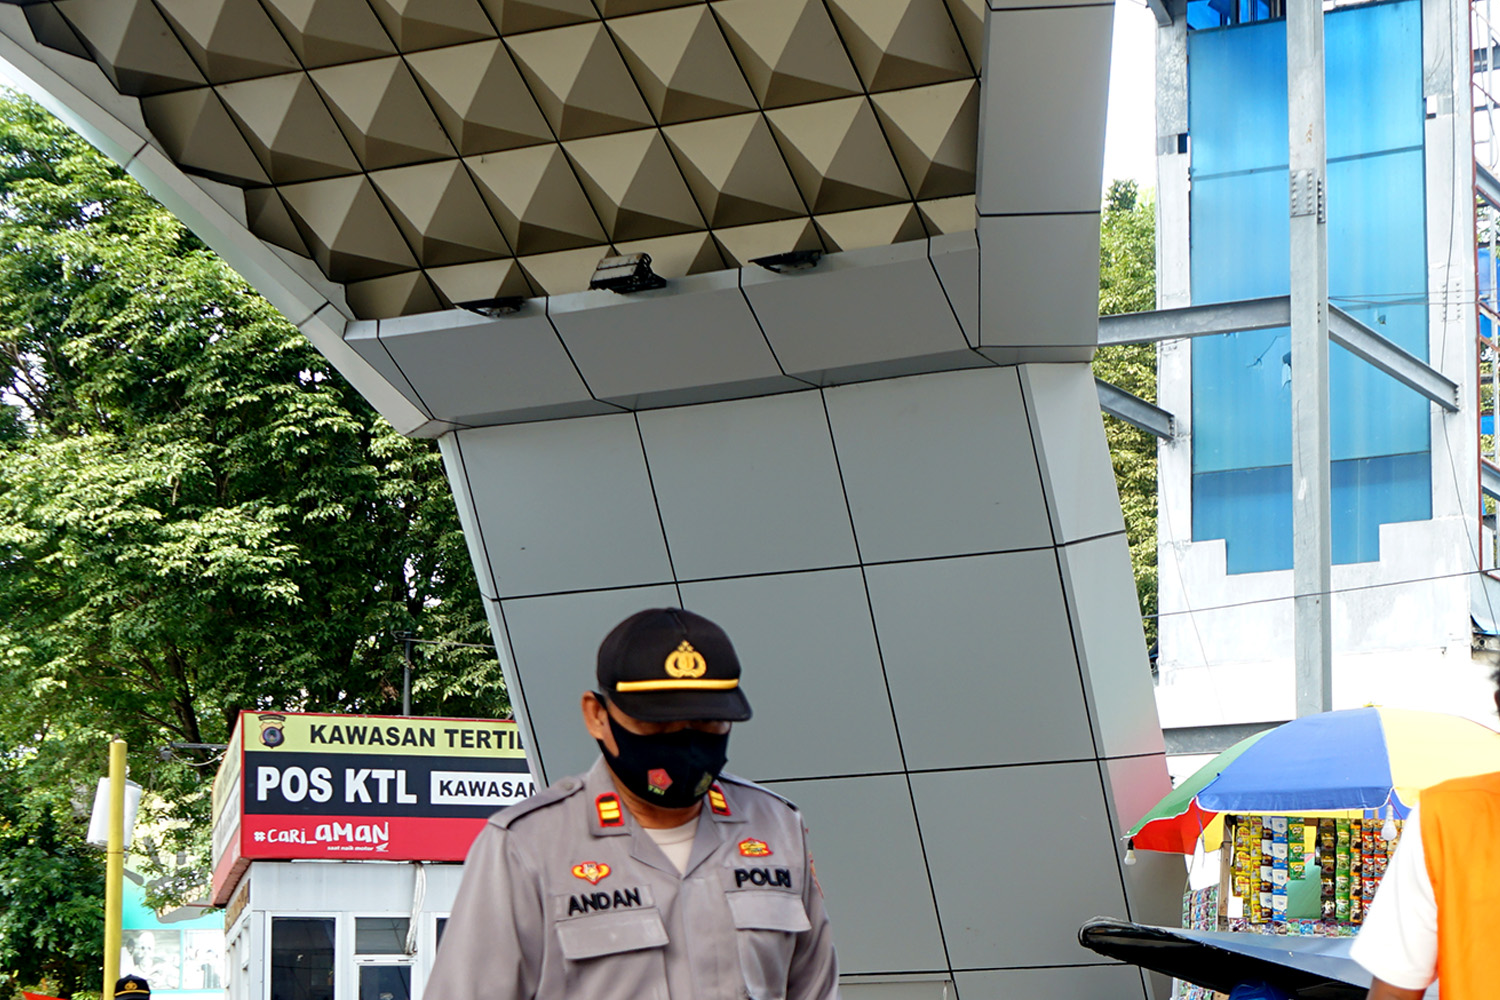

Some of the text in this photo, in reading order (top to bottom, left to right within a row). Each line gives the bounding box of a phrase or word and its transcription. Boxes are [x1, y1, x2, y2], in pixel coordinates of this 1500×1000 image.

[310, 725, 435, 747] KAWASAN
[257, 766, 417, 804] POS KTL
[734, 868, 791, 888] POLRI
[568, 887, 642, 916] ANDAN
